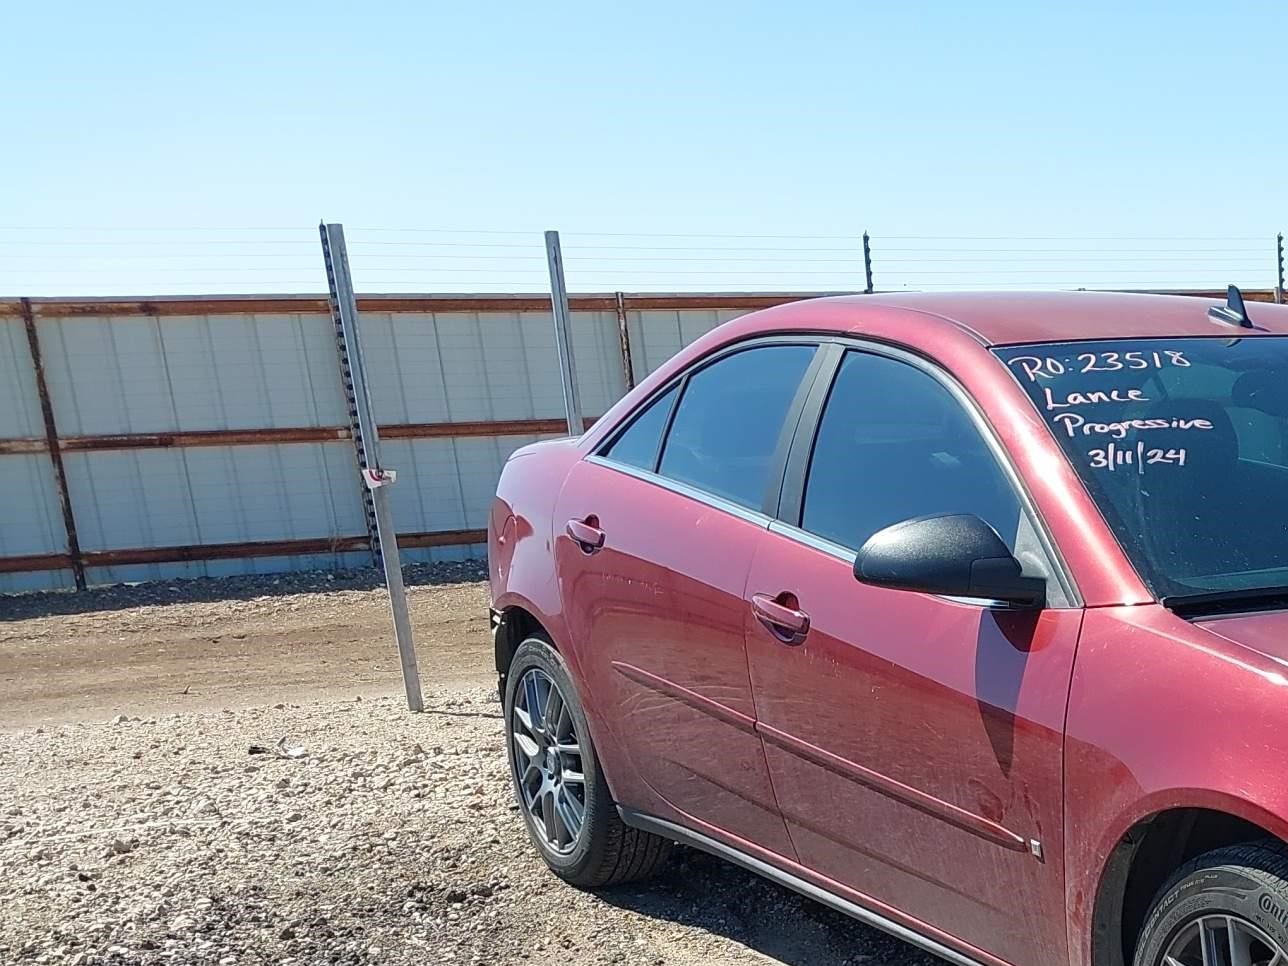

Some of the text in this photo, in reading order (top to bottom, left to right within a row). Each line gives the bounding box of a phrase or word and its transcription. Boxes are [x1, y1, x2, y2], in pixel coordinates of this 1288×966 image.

[1045, 387, 1150, 411] Lance
[1054, 412, 1215, 438] Progressive
[1087, 441, 1187, 475] 3/11/24
